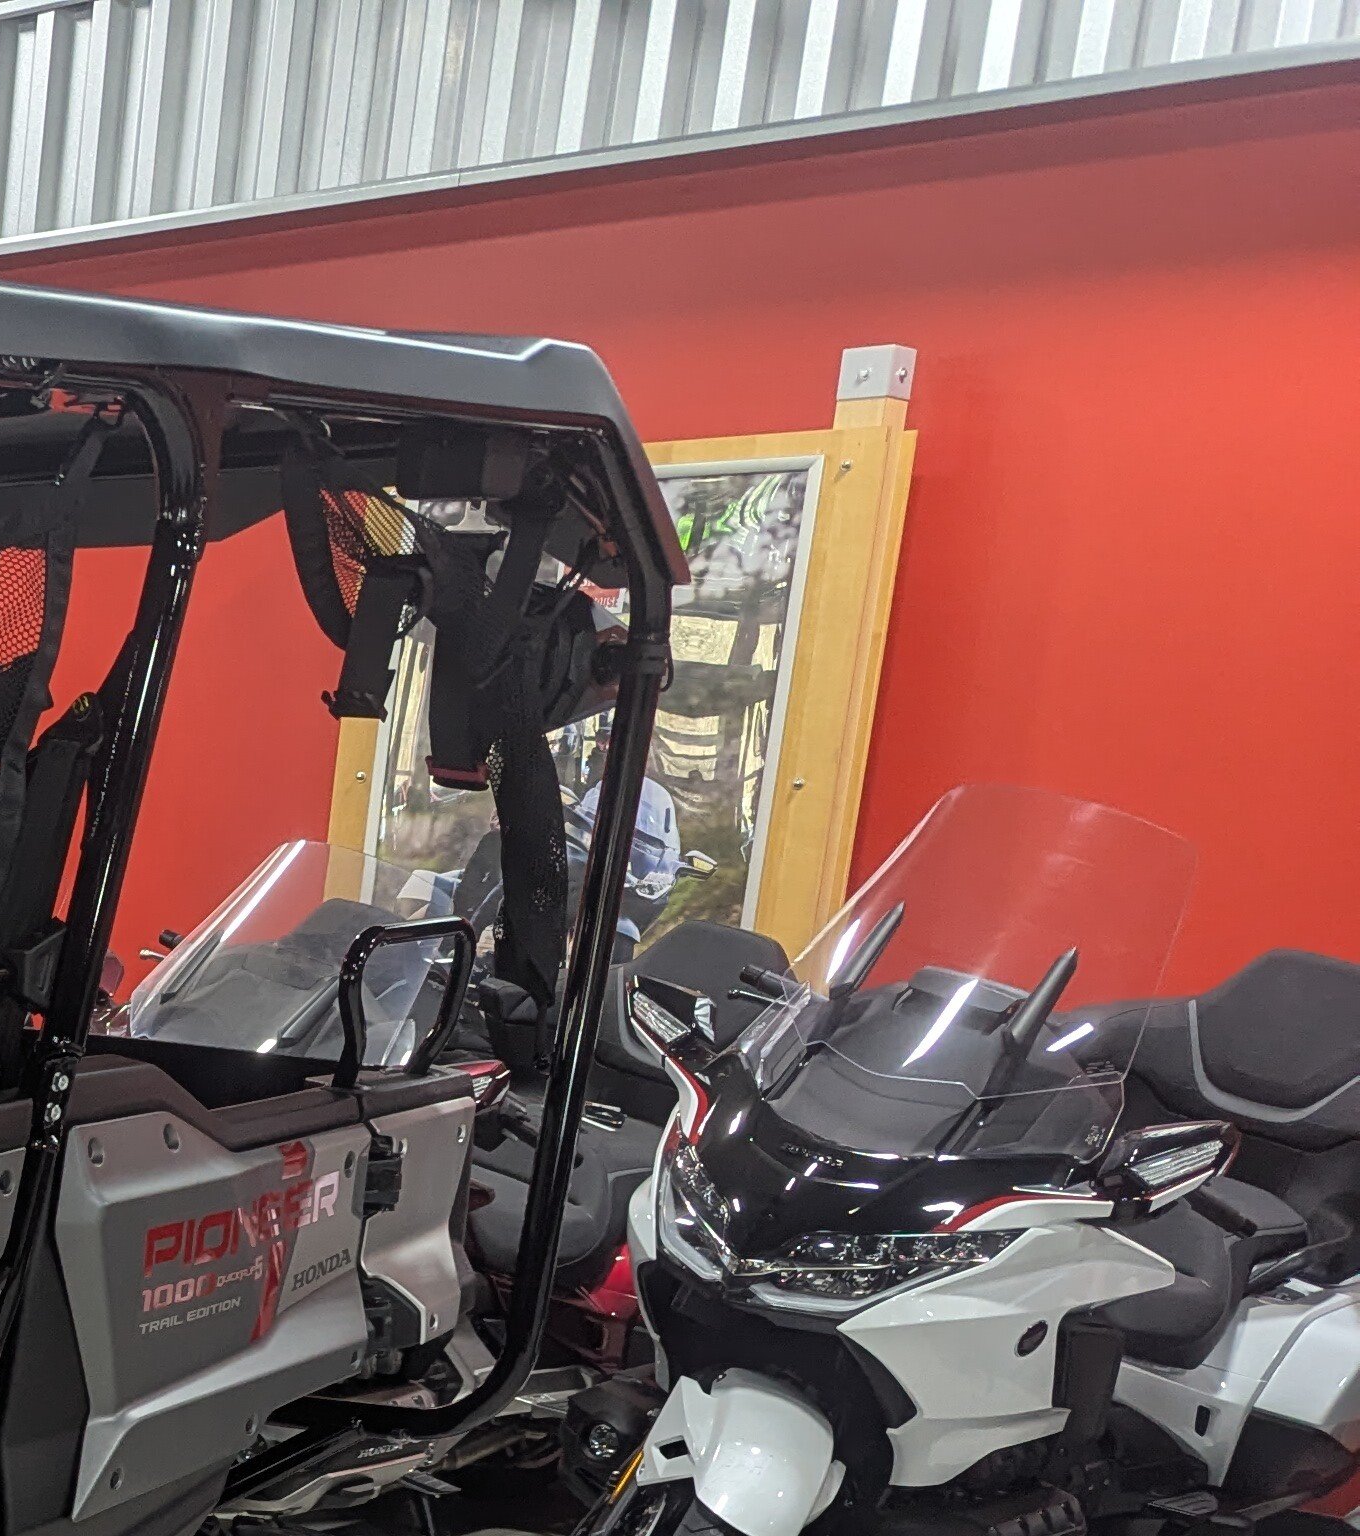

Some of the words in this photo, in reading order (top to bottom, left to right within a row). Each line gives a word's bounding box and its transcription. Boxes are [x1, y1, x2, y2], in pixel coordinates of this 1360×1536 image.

[143, 1171, 341, 1279] PIONEER
[292, 1249, 352, 1292] HONDA
[142, 1272, 218, 1312] 1000
[139, 1313, 184, 1335] TRAIL
[186, 1297, 242, 1322] EDITION
